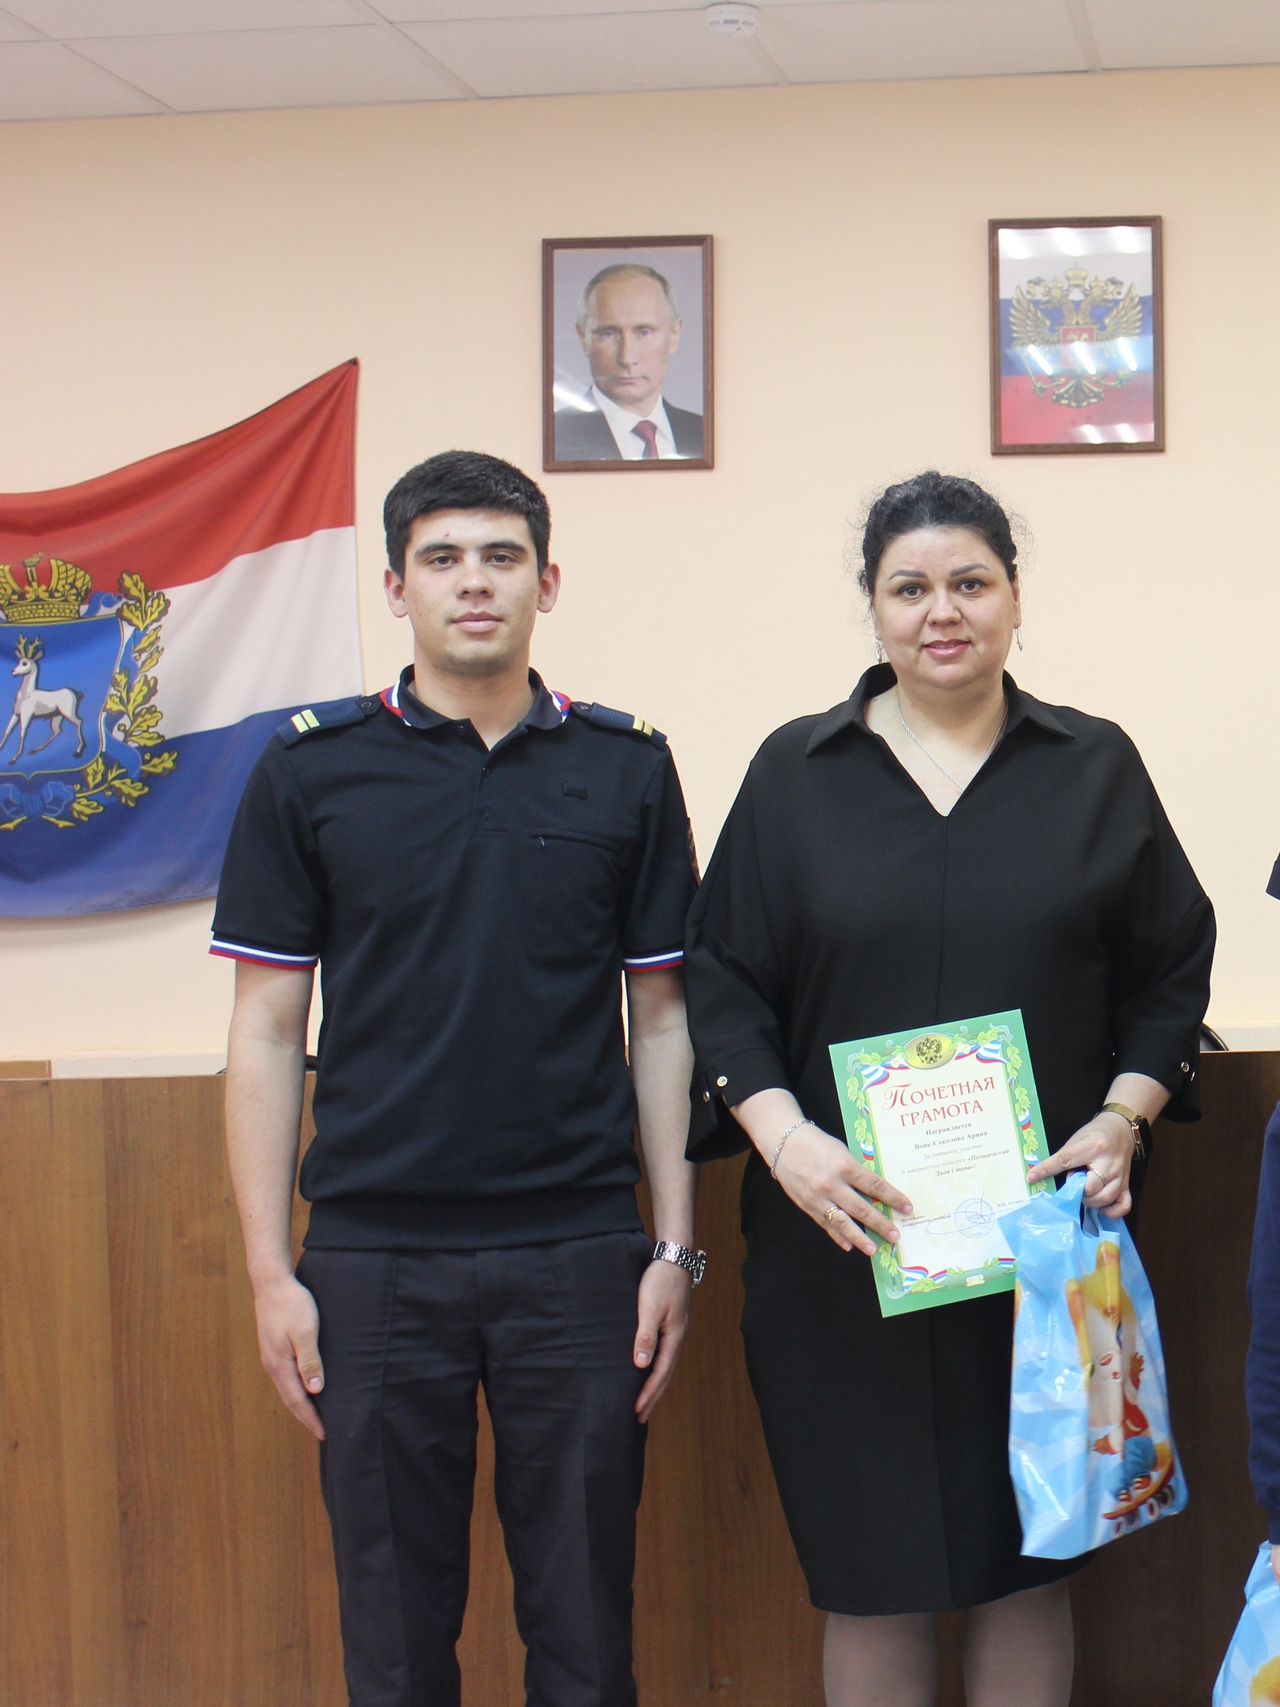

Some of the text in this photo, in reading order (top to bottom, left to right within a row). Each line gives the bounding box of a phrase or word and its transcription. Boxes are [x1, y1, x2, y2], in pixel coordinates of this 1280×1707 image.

[881, 1076, 995, 1111] ПОЧЕТНАЯ
[900, 1099, 984, 1128] ГРАМОТА
[925, 1122, 972, 1137] Награждается
[966, 1130, 988, 1141] Арина
